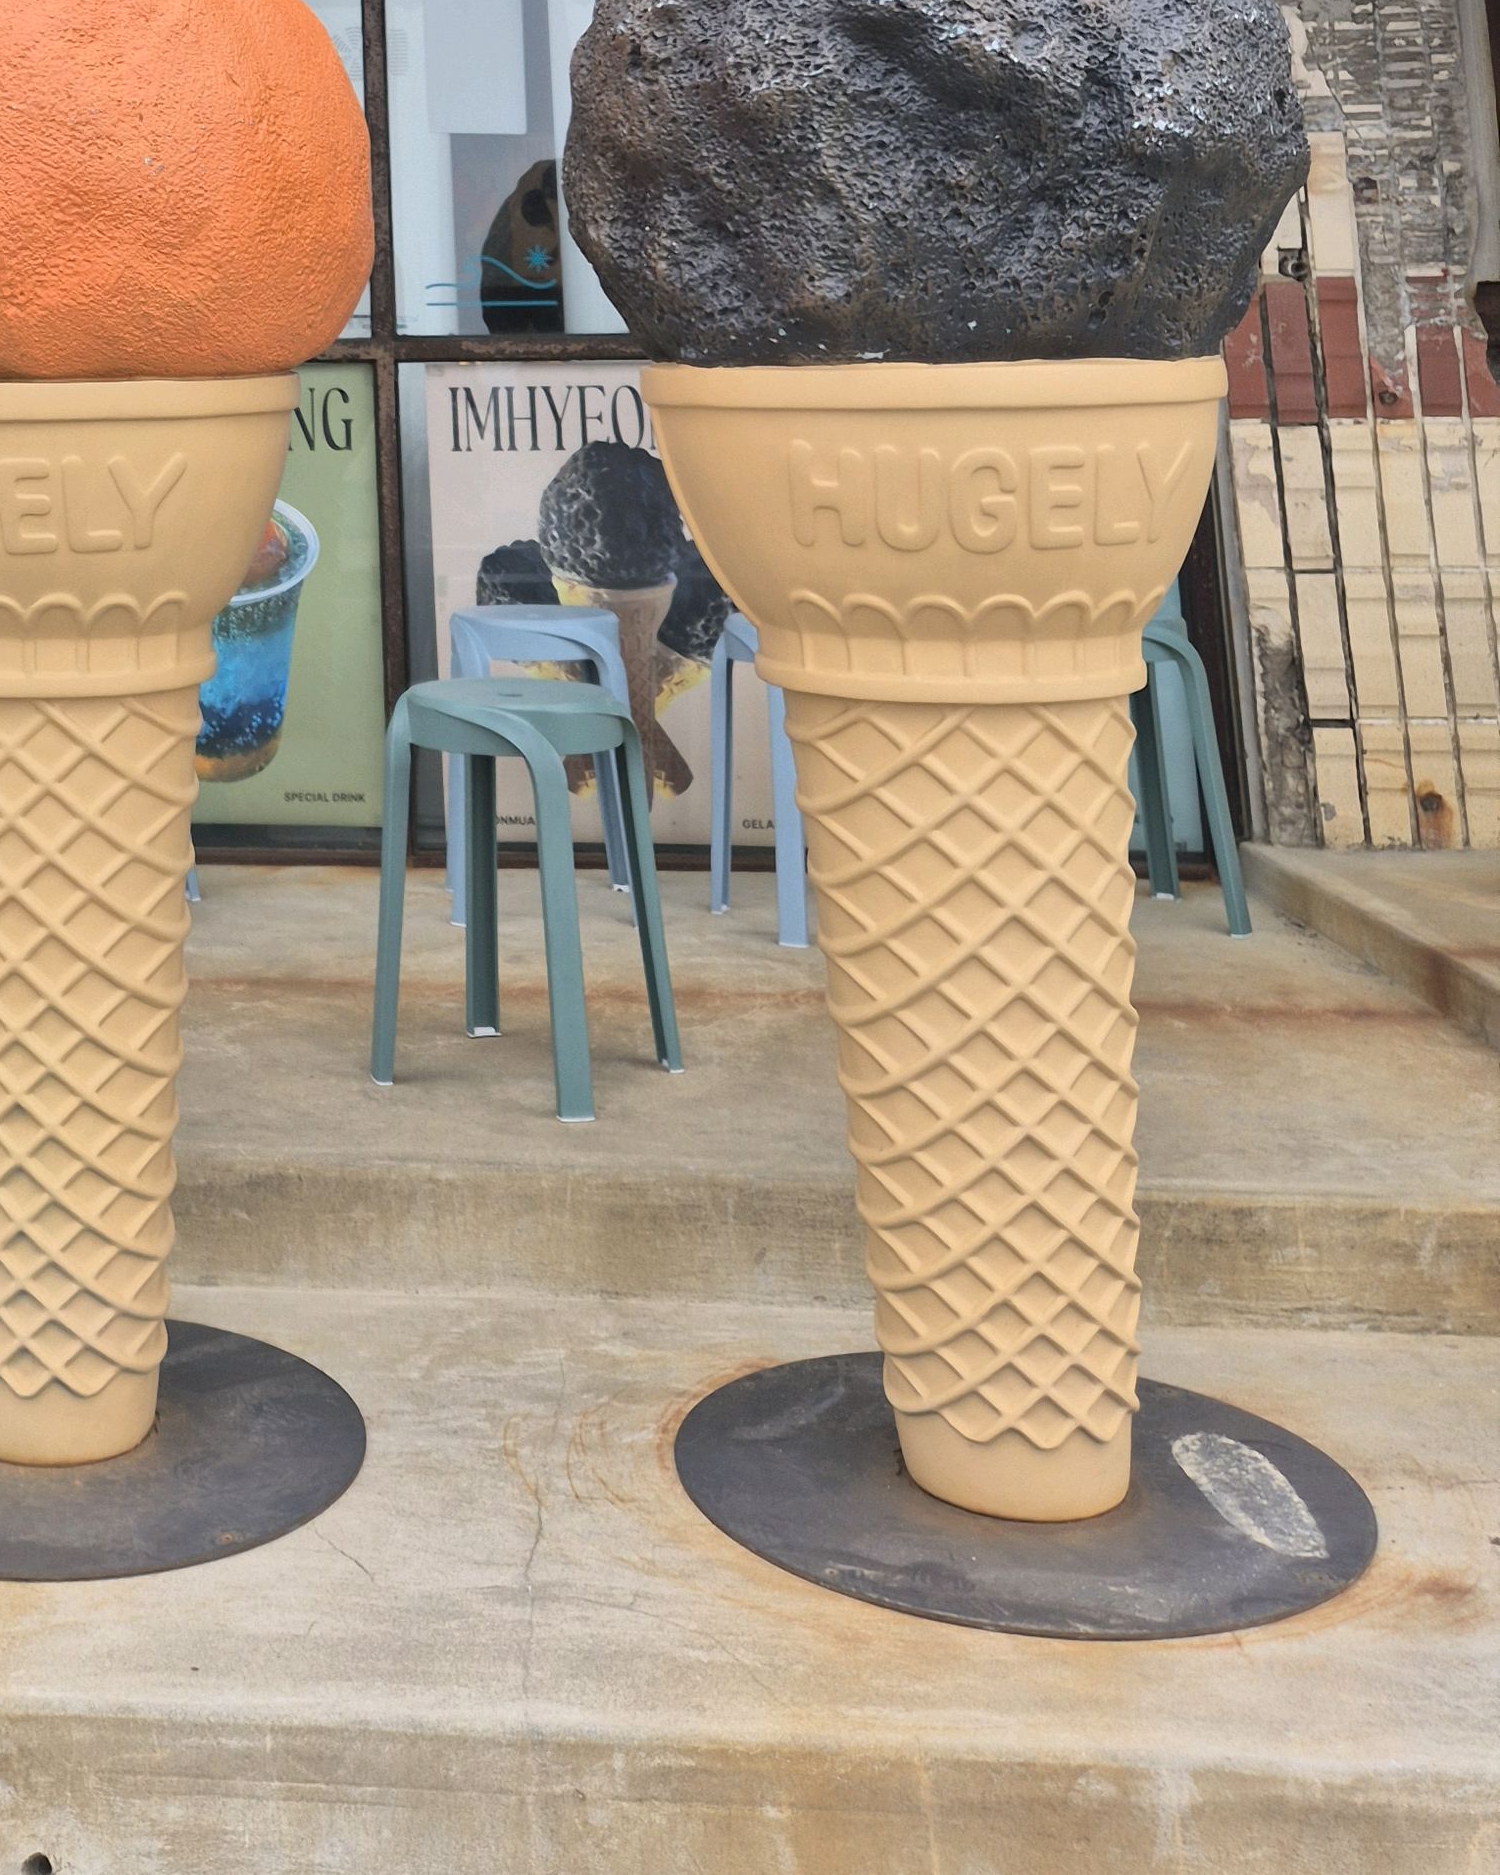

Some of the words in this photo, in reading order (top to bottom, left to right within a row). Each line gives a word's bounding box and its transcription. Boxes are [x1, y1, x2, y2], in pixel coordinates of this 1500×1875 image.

[449, 384, 655, 453] IMHYEO
[787, 438, 1192, 555] HUGELY
[283, 792, 329, 803] SPECIAL
[332, 793, 366, 803] DRINK
